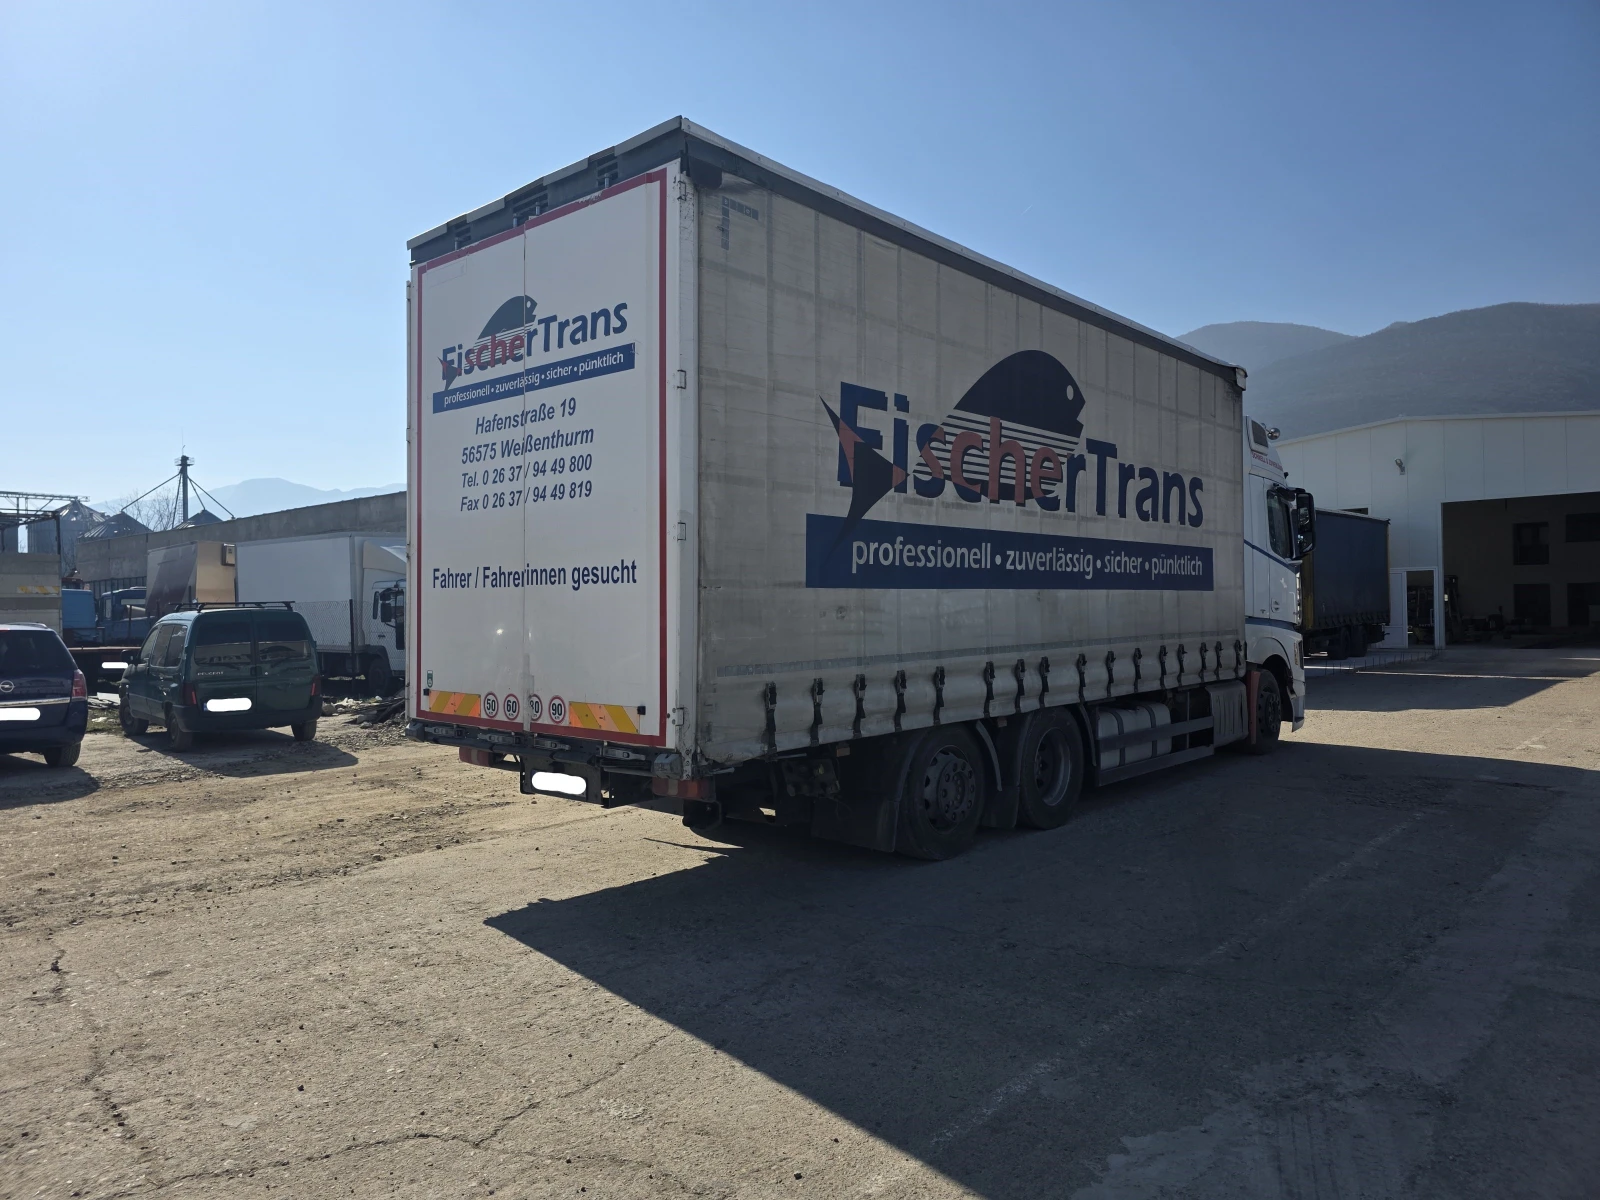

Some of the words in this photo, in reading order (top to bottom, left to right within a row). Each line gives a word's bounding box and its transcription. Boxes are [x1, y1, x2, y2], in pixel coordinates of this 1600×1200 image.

[441, 302, 628, 381] FischerTrans
[444, 385, 490, 408] professionell
[495, 372, 540, 393] zuverlässig
[546, 365, 572, 380] sicher
[579, 351, 624, 376] pünktlich
[475, 403, 555, 435] Hafenstraße
[560, 397, 576, 418] 19
[461, 442, 497, 465] 56575
[500, 428, 594, 459] Weißenthurm
[836, 381, 1204, 528] FischerTrans
[461, 471, 478, 488] Tel.
[482, 470, 489, 485] 0
[492, 467, 505, 484] 26
[508, 465, 522, 482] 37
[532, 460, 547, 478] 94
[550, 457, 565, 475] 49
[569, 453, 592, 473] 800
[460, 496, 480, 512] Fax
[482, 494, 489, 509] 0
[492, 492, 505, 509] 26
[508, 490, 522, 507] 37
[532, 485, 547, 503] 94
[550, 483, 565, 500] 49
[569, 480, 592, 499] 819
[432, 567, 472, 589] Fahrer
[482, 564, 567, 588] Fahrerinnen
[571, 559, 637, 591] gesucht
[852, 536, 991, 574] professionell
[1006, 547, 1093, 580] zuverlässig
[1104, 551, 1142, 574] sicher
[1151, 554, 1203, 580] pünktlich
[486, 698, 496, 712] 50
[506, 699, 517, 714] 60
[551, 702, 563, 717] 90
